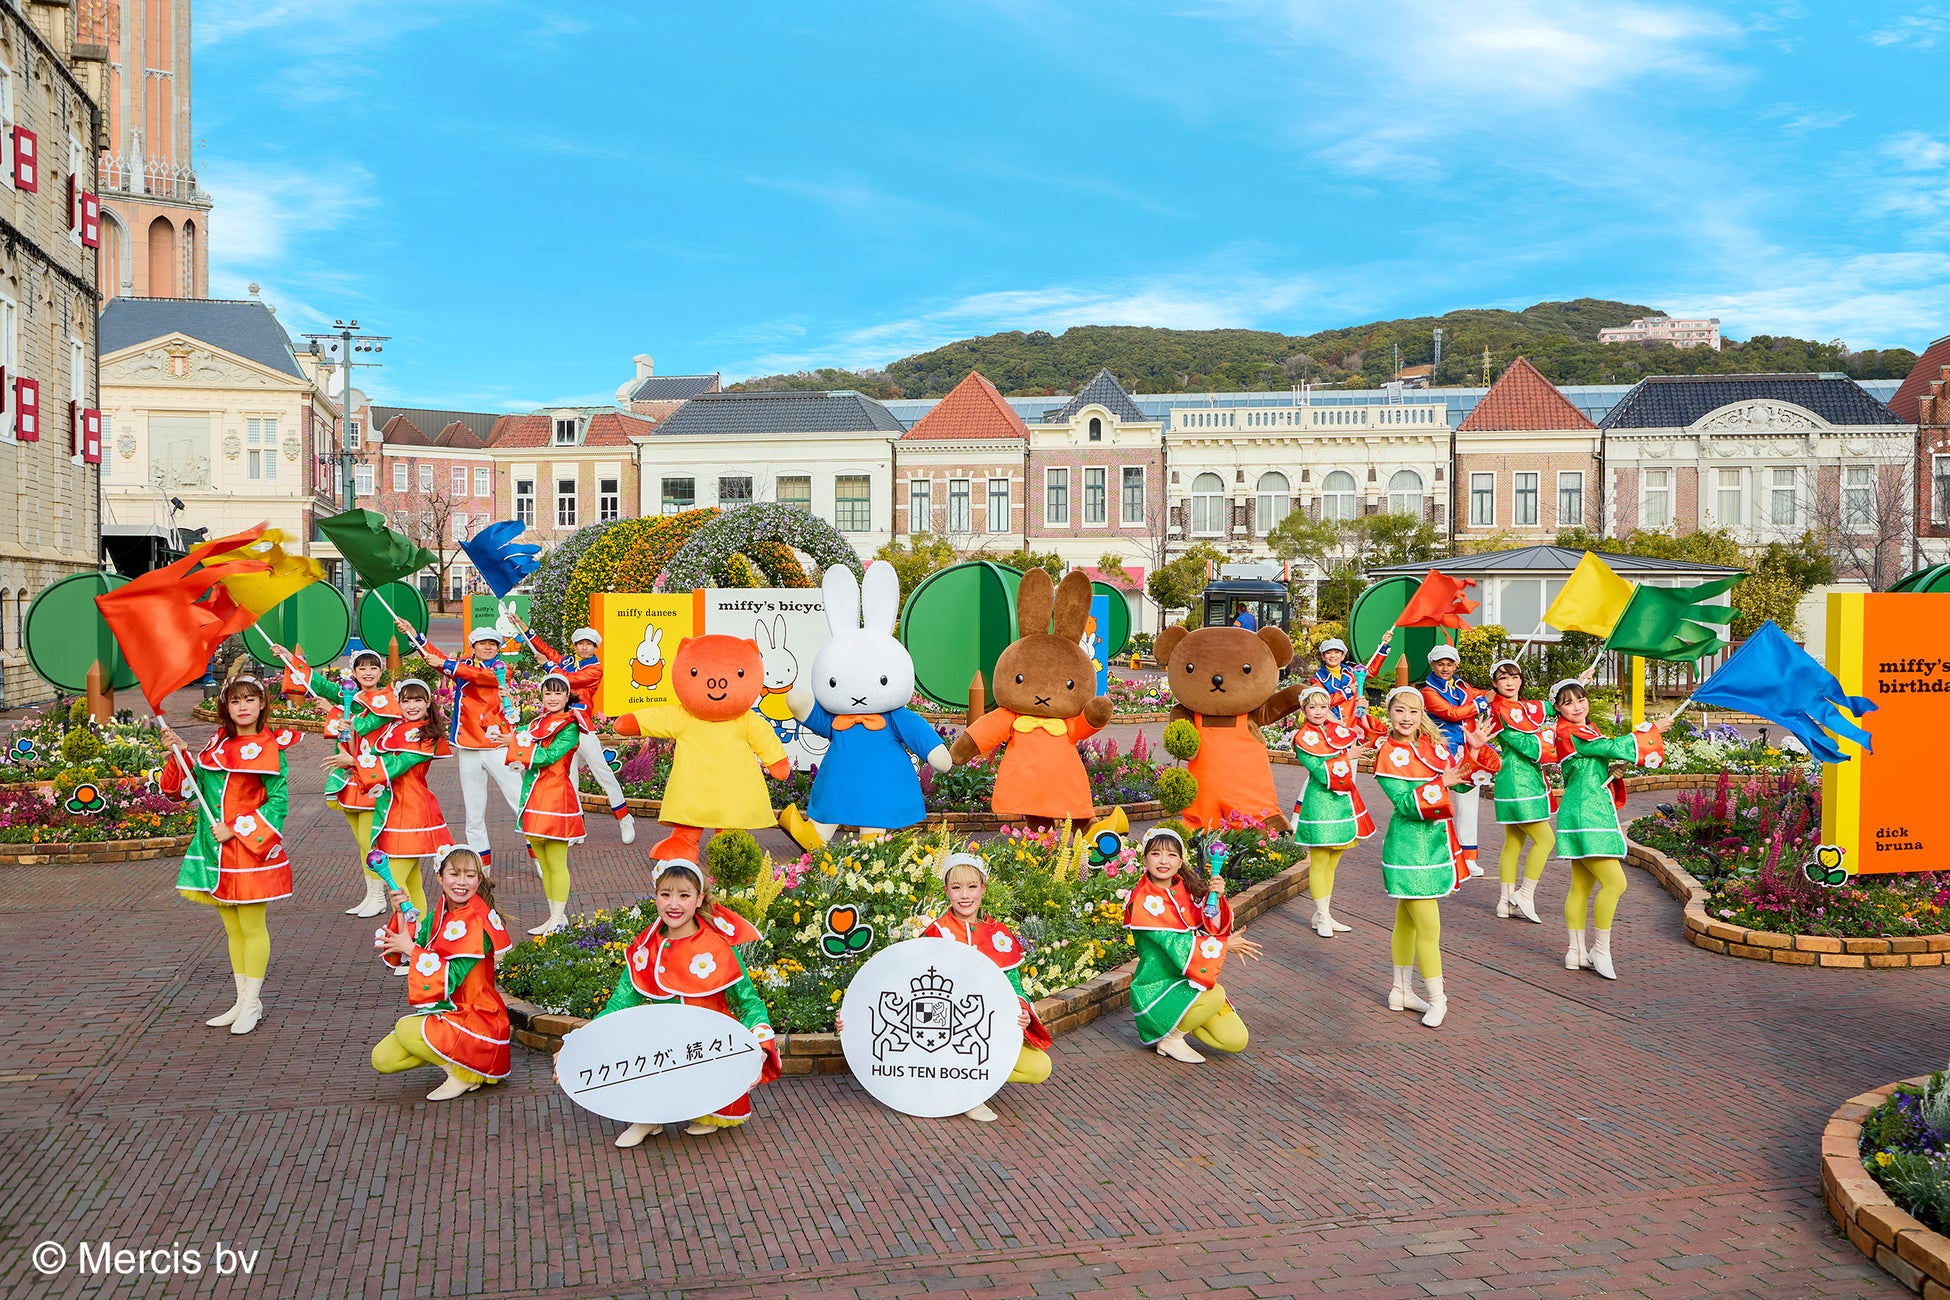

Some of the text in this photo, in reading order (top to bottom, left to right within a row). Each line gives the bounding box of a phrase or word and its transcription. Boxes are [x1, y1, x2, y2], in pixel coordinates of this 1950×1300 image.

[718, 601, 825, 614] miffy’s bicyc
[617, 608, 677, 619] miffy dances
[1879, 658, 1950, 676] miffy’s
[628, 696, 644, 704] dick
[1876, 827, 1909, 838] dick
[1875, 841, 1923, 851] bruna
[871, 1065, 989, 1080] HUIS TEN BOSCH
